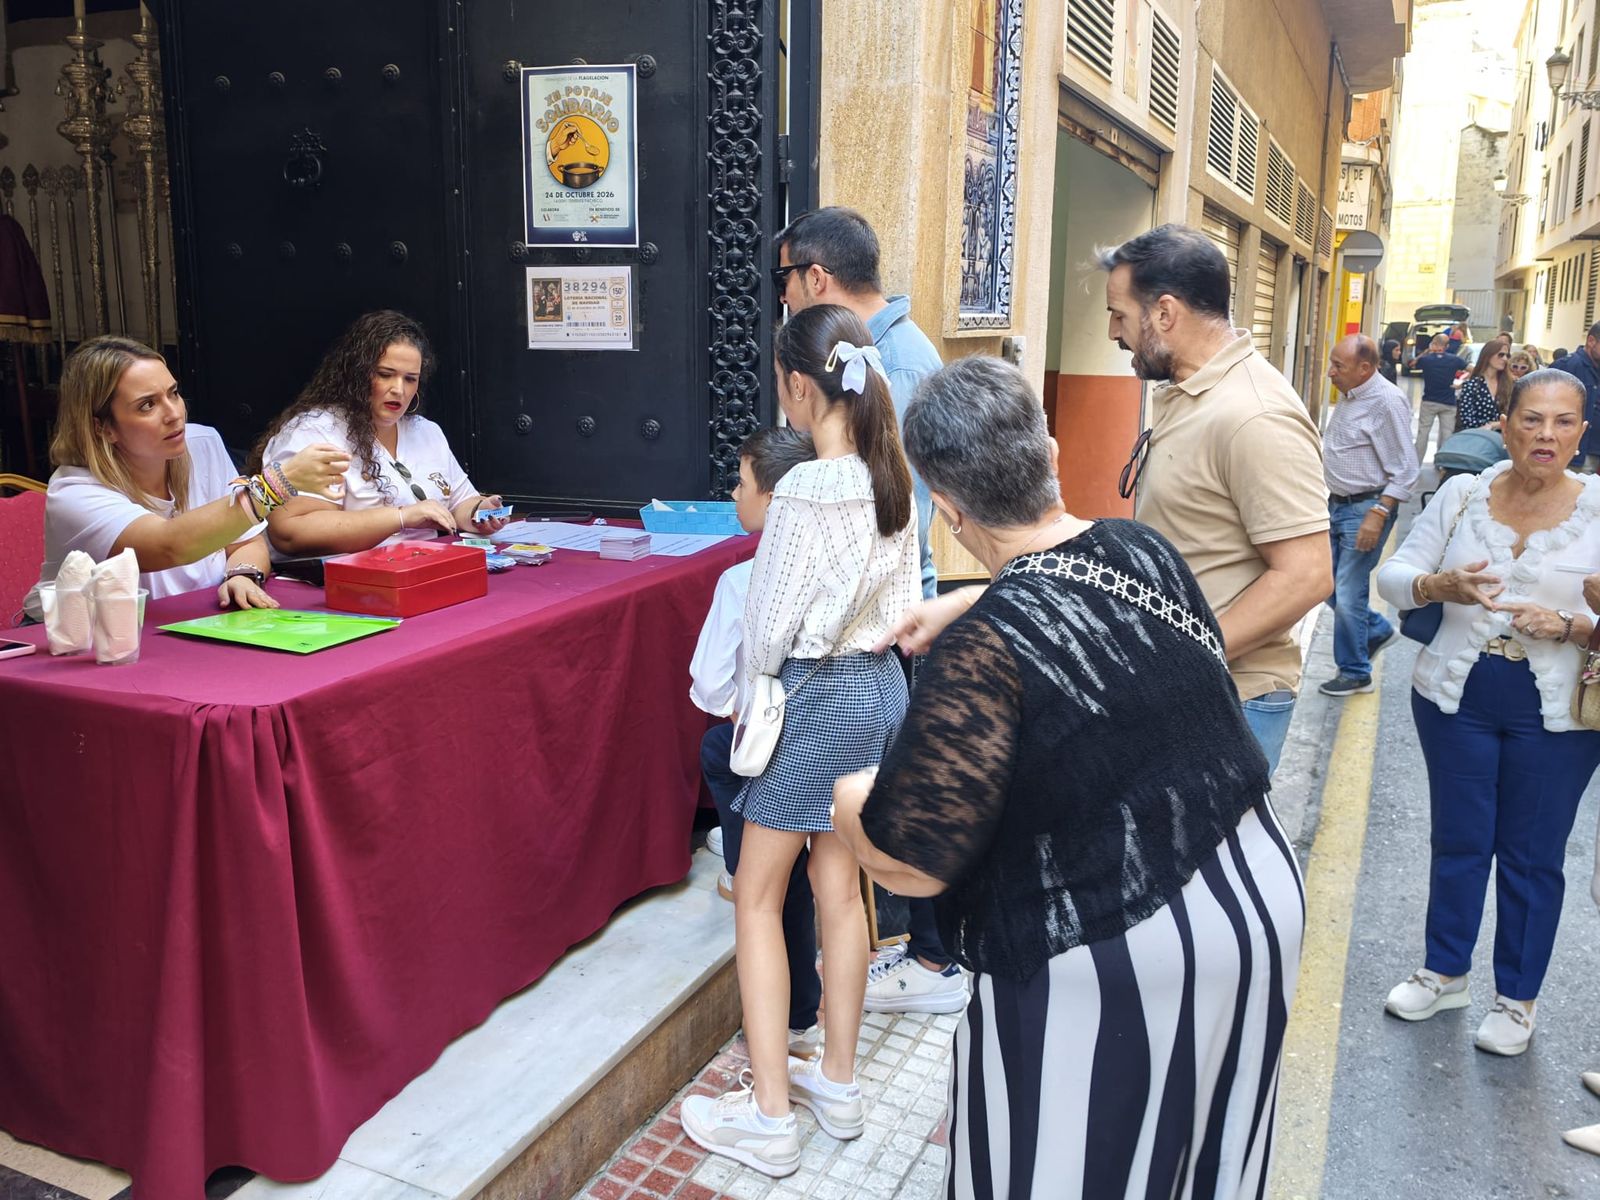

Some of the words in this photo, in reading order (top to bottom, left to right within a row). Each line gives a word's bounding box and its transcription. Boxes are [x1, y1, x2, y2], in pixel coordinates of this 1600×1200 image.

[535, 97, 619, 133] SOLIDARIO
[1354, 168, 1364, 180] DE
[1338, 213, 1363, 226] MOTOS
[563, 281, 607, 291] 38294
